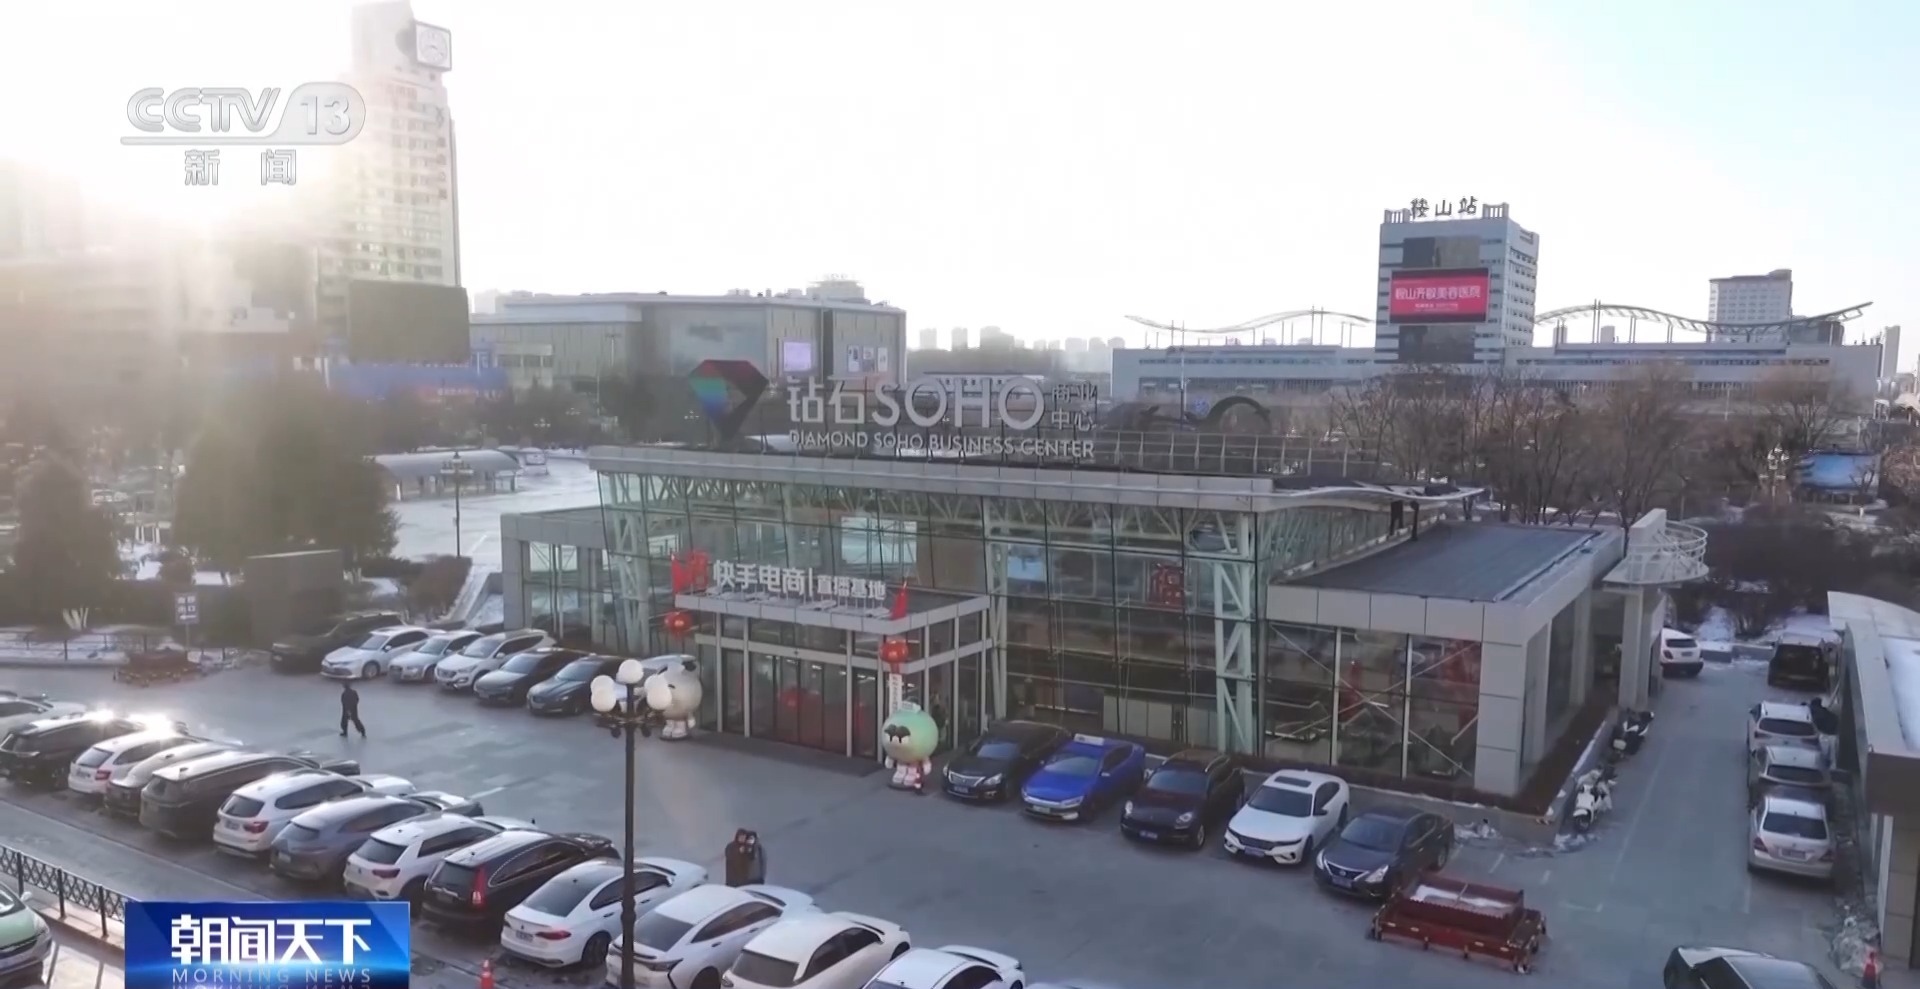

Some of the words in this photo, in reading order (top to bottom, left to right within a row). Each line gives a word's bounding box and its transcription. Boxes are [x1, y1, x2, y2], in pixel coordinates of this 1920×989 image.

[1410, 196, 1478, 219] 鞍山站
[1051, 382, 1097, 403] 商业
[1051, 408, 1096, 432] 中心
[788, 430, 868, 448] DIAMOND
[873, 431, 923, 450] SOHO
[929, 434, 1014, 455] BUSINESS
[1020, 440, 1095, 458] CENTER
